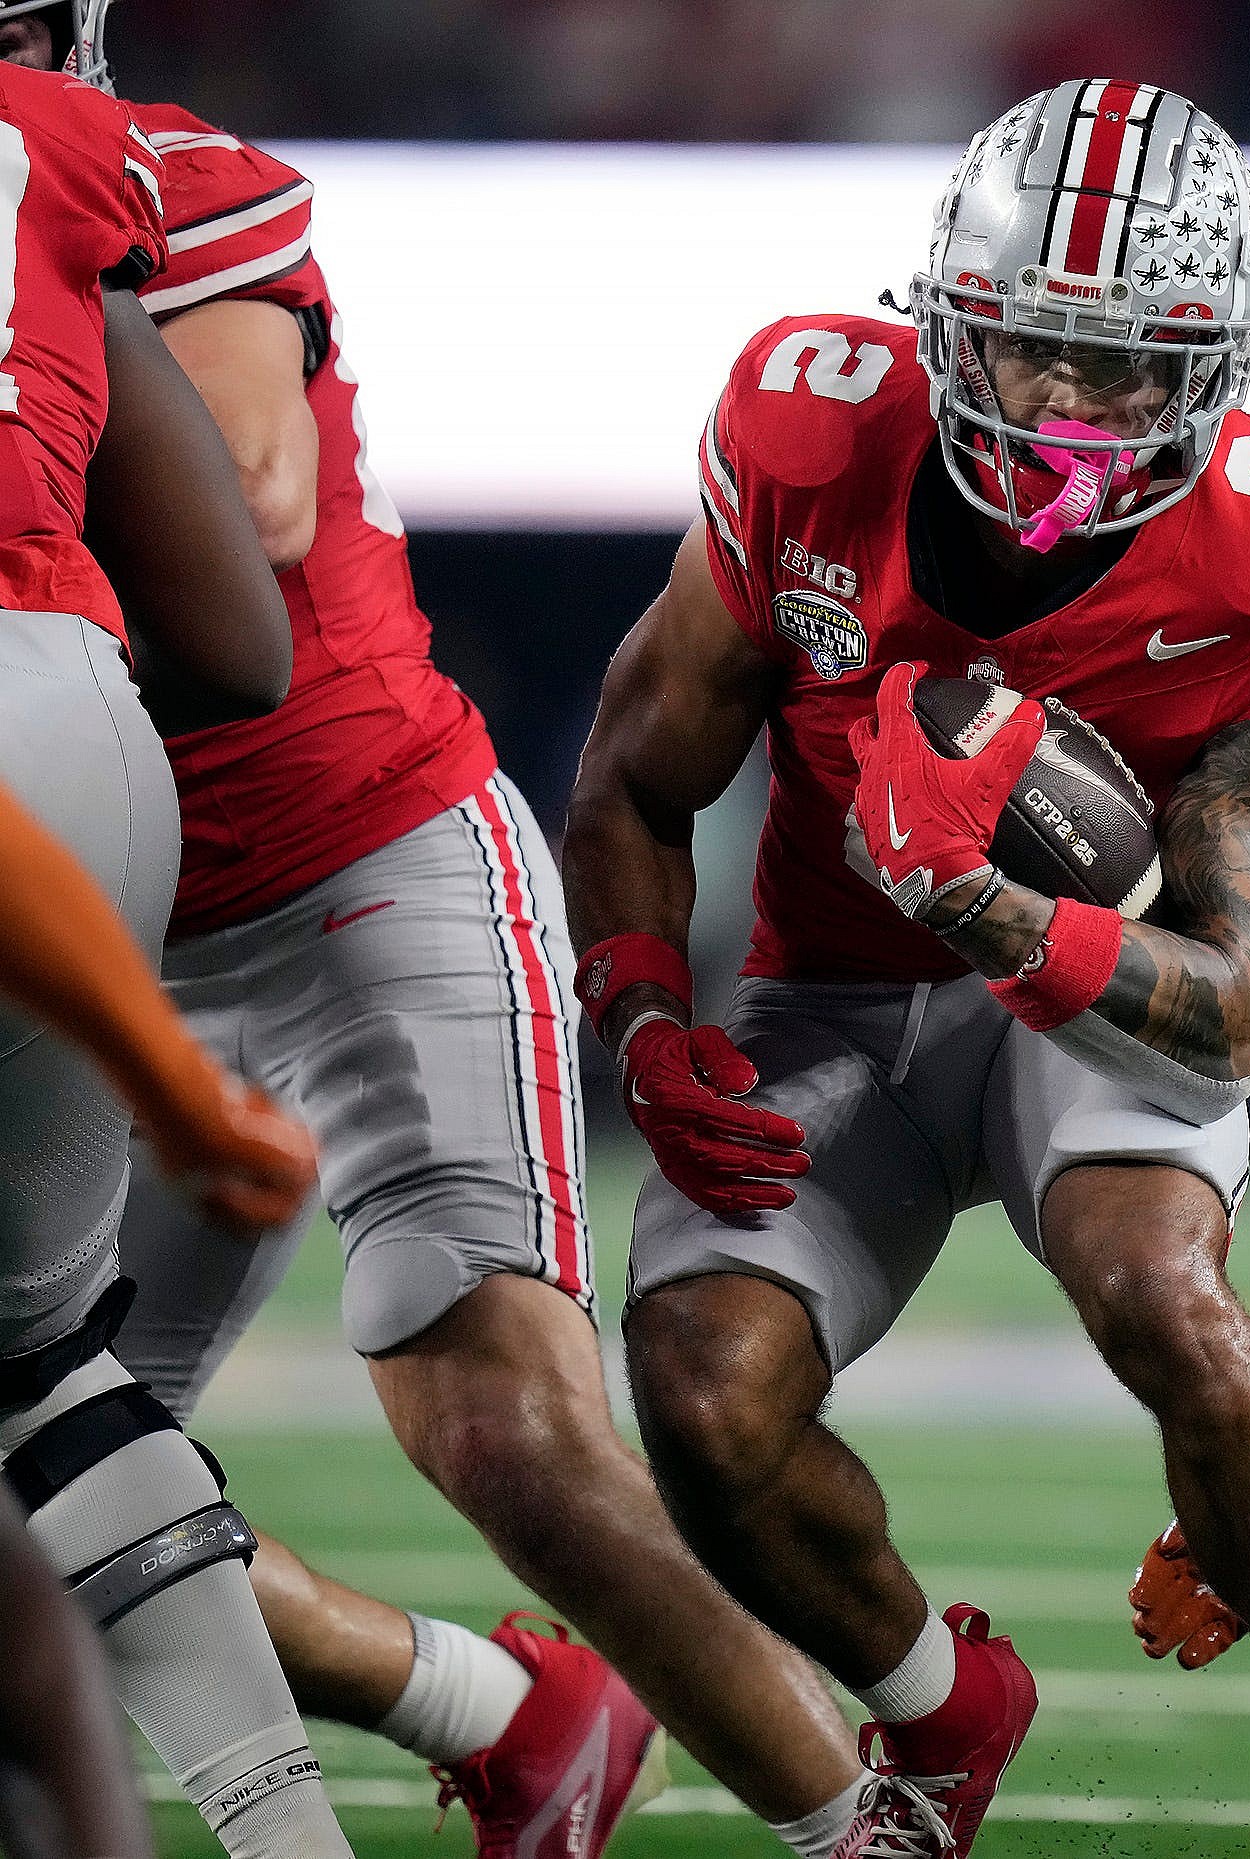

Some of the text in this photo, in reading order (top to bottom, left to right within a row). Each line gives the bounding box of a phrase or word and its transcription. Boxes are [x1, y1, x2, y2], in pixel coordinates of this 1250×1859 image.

[758, 328, 895, 404] 2
[779, 597, 859, 633] GOODYEAR
[779, 608, 860, 658] COTTON
[798, 625, 848, 657] BOWL
[979, 880, 1000, 905] Jesus
[957, 912, 973, 927] Our
[219, 1769, 282, 1812] NIKE
